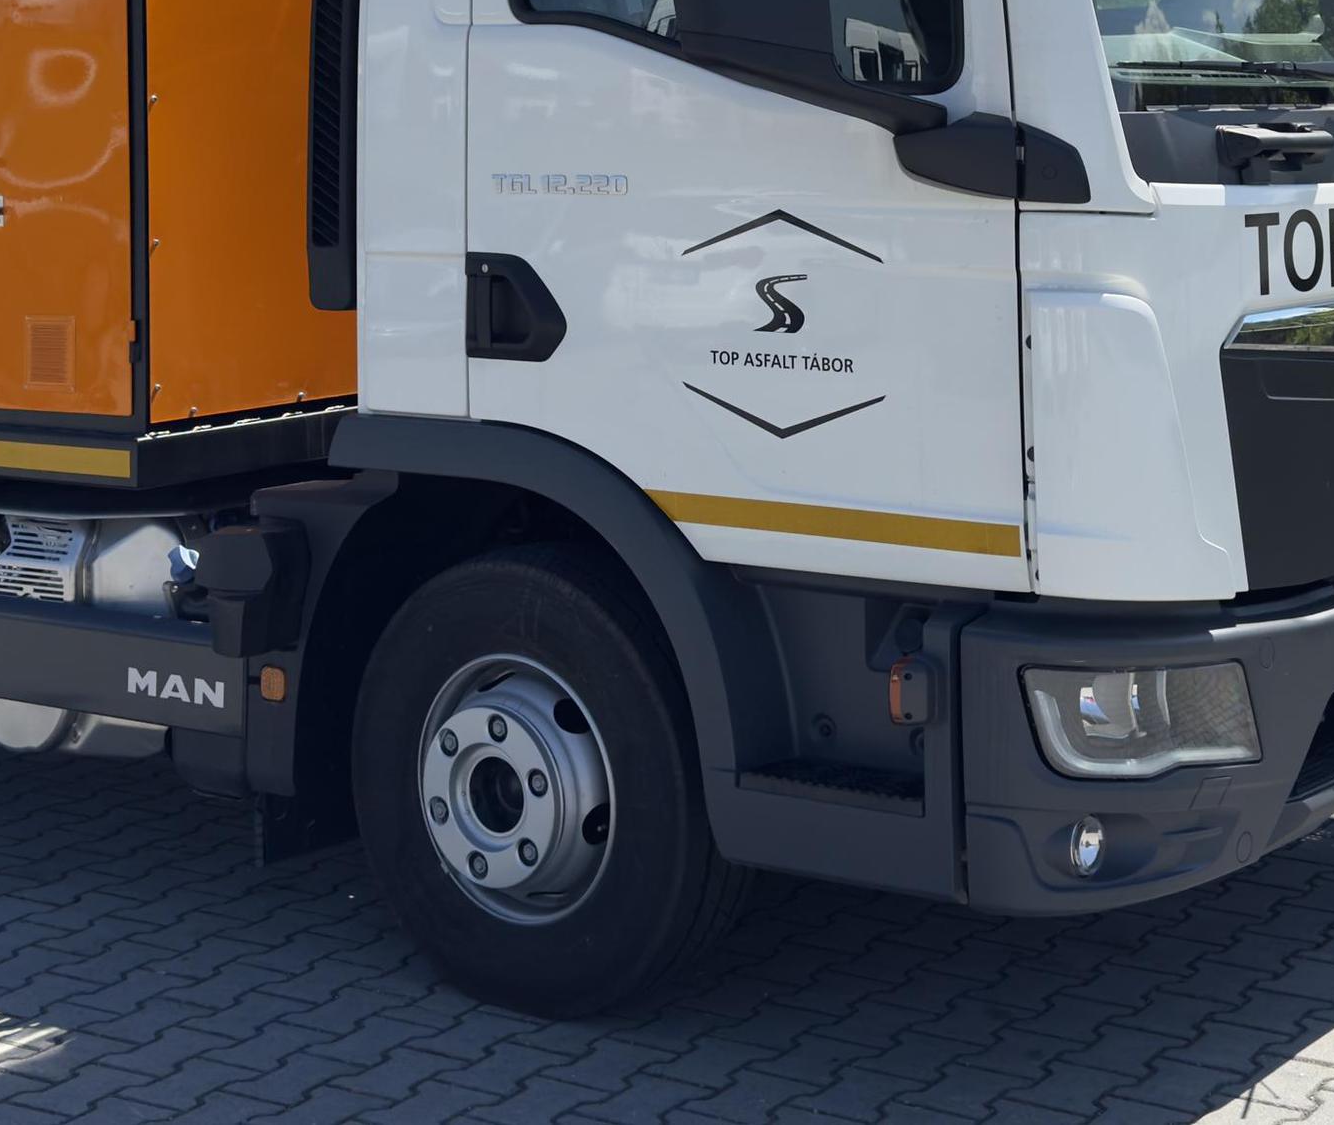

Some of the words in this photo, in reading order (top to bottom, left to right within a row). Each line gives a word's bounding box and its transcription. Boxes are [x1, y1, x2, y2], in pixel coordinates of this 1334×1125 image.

[491, 174, 537, 195] TGL
[540, 174, 628, 196] 12.220
[710, 350, 739, 366] TOP
[743, 352, 797, 370] ASFALT
[802, 353, 854, 373] TÁBOR
[127, 666, 225, 709] MAN
